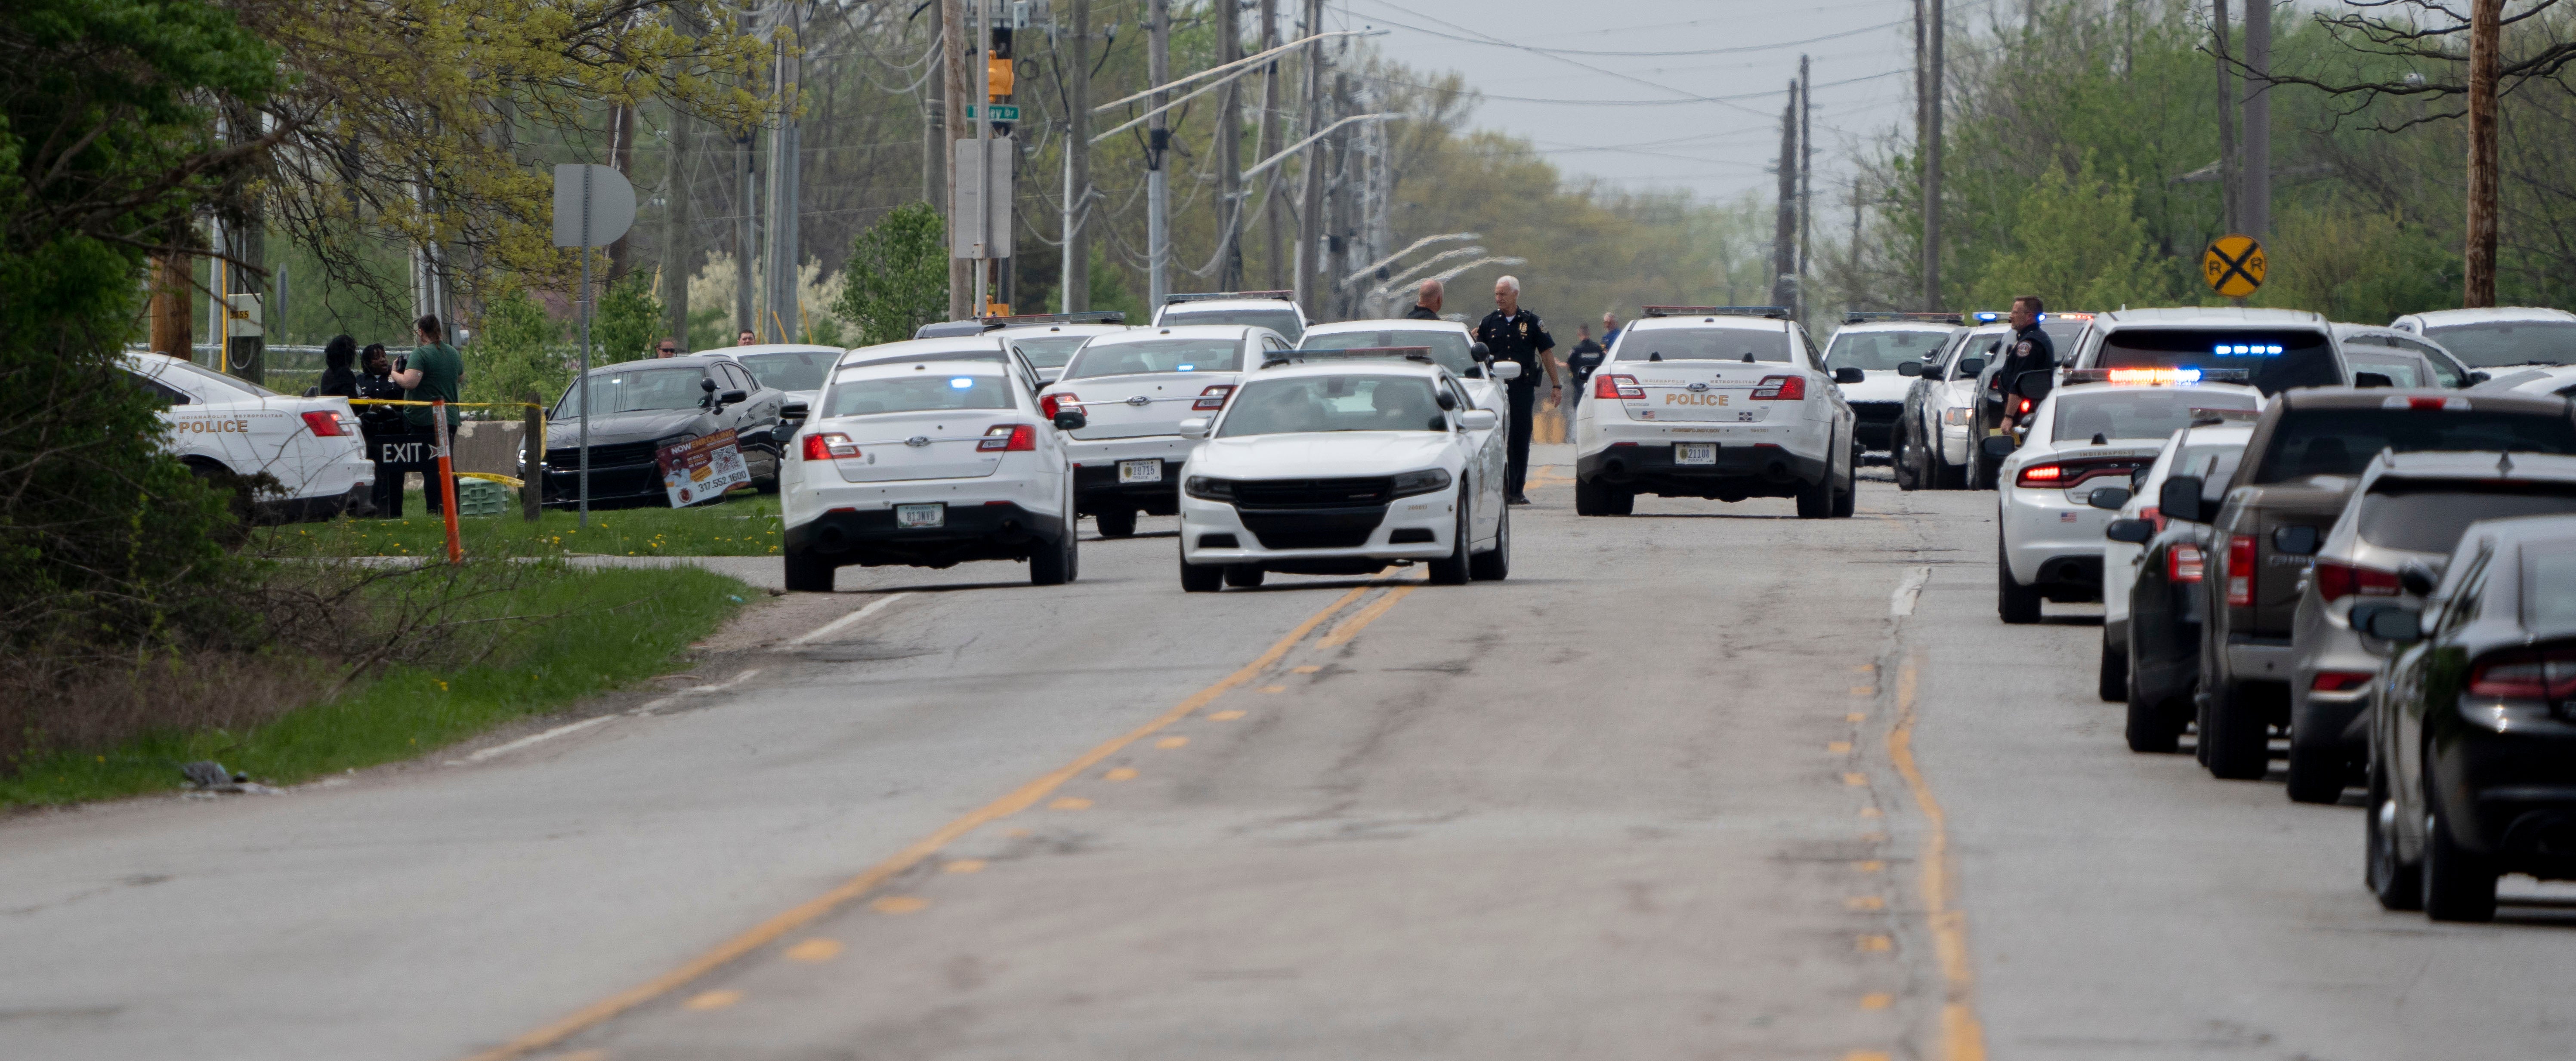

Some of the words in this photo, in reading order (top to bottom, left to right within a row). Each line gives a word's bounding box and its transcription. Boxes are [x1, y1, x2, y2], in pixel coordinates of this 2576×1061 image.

[2209, 261, 2221, 275] R
[2251, 257, 2263, 271] R
[1666, 393, 1729, 406] POLICE
[179, 419, 248, 434] POLICE
[671, 442, 692, 454] NOW
[691, 430, 735, 448] ENROLLING
[383, 443, 422, 463] EXIT
[698, 470, 747, 492] 317.552.1600
